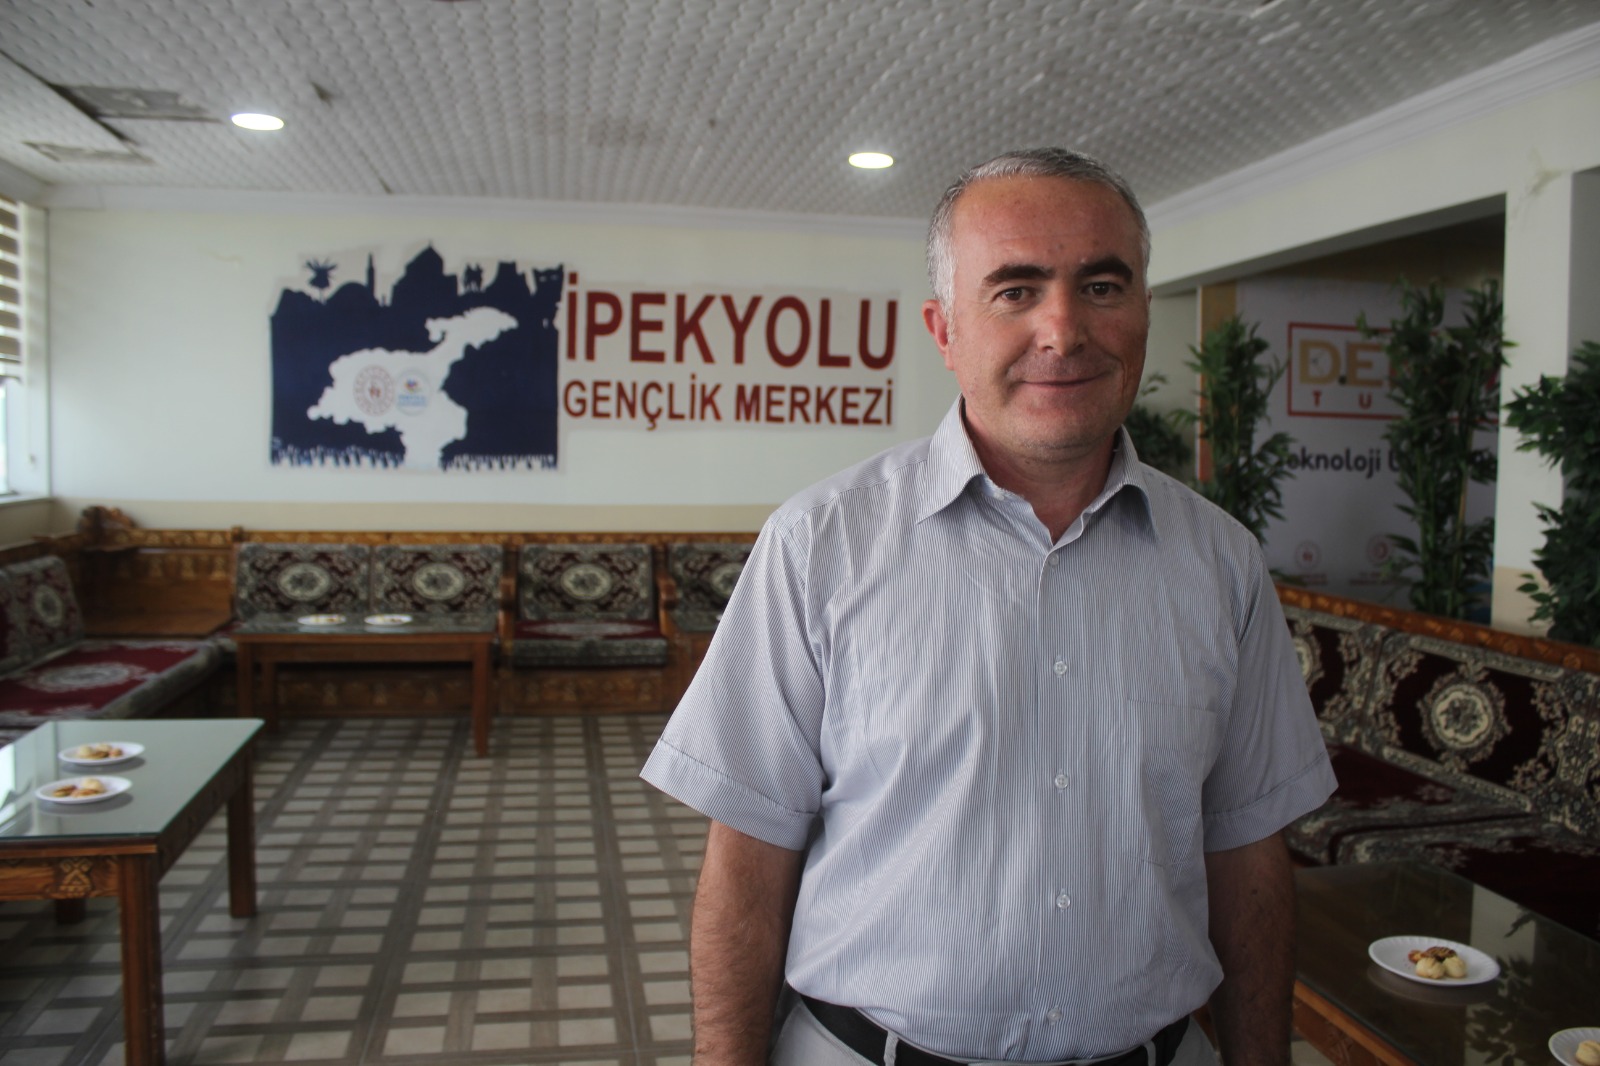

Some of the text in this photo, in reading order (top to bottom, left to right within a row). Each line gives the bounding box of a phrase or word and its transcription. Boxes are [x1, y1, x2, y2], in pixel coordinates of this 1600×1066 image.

[566, 272, 899, 370] İPEKYOLU
[563, 373, 894, 431] GENÇLİK MERKEZİ
[1280, 447, 1381, 479] eknoloji
